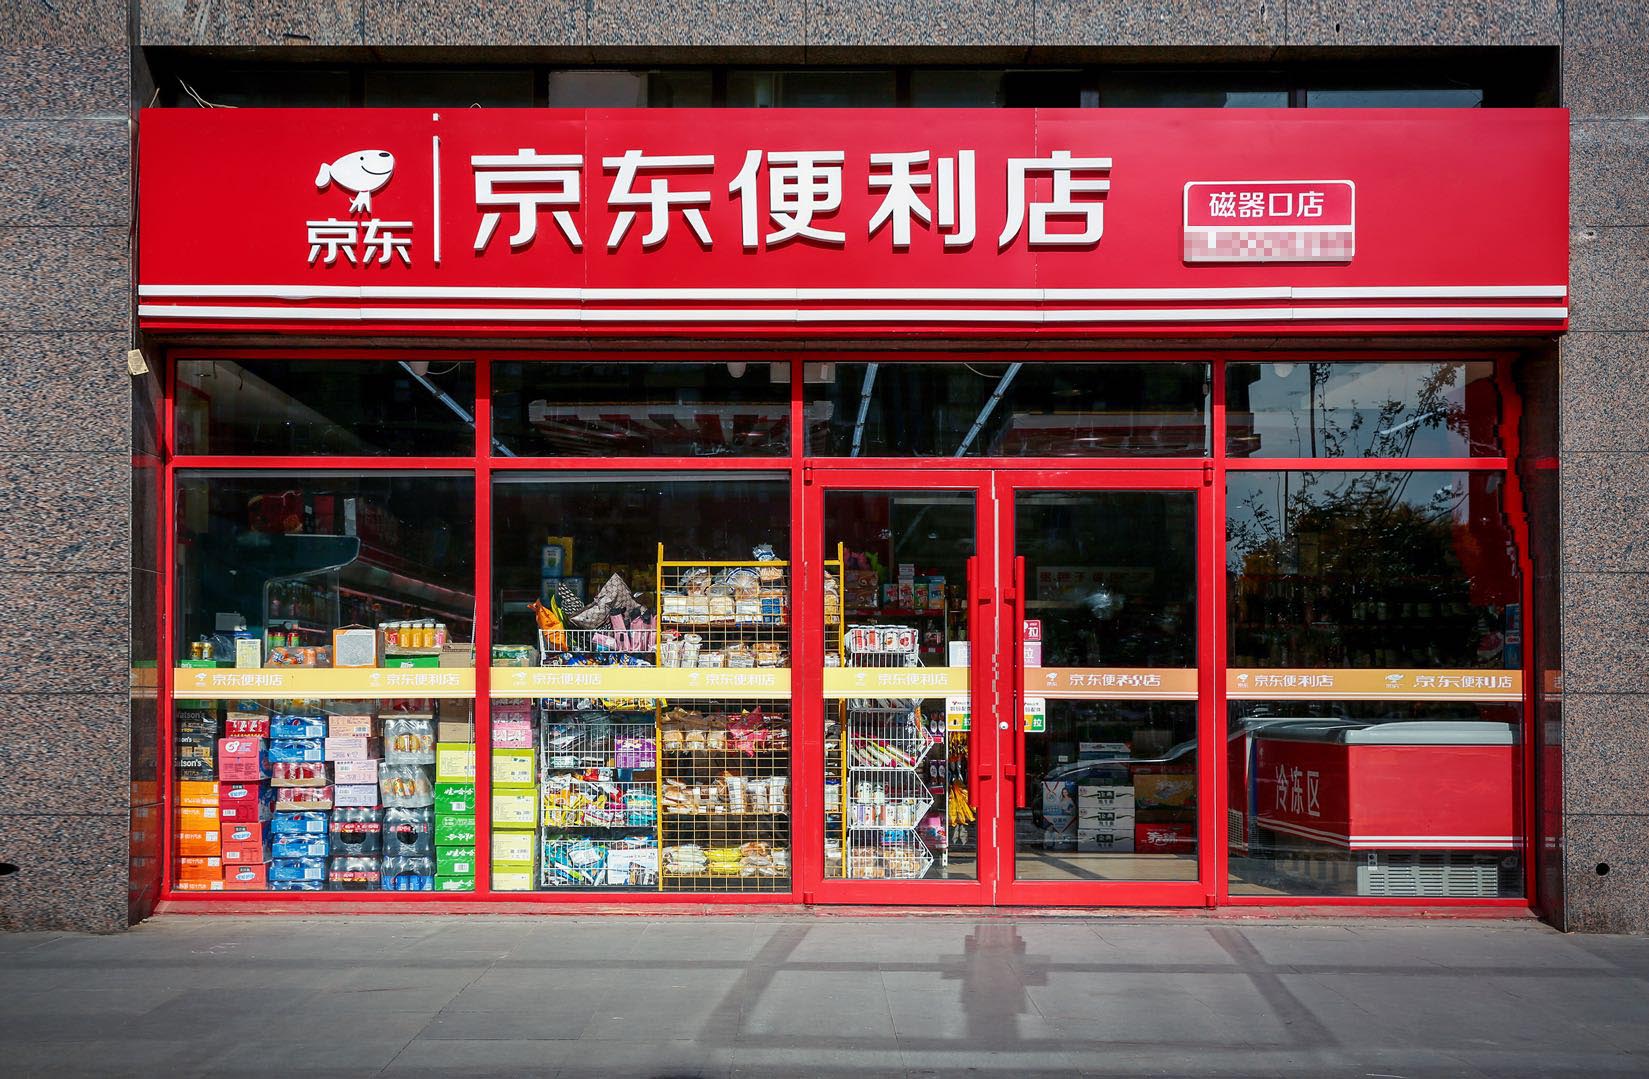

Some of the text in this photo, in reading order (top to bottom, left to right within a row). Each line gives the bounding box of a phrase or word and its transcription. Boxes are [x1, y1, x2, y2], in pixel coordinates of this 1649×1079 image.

[471, 148, 1113, 251] 京东便利店
[1208, 190, 1325, 220] 磁器口店
[306, 217, 413, 265] 京东
[212, 674, 284, 686] 京东便利店
[1254, 674, 1334, 687] 京东便利店
[1413, 675, 1513, 688] 京东便利店
[1275, 764, 1320, 817] 冷冻区
